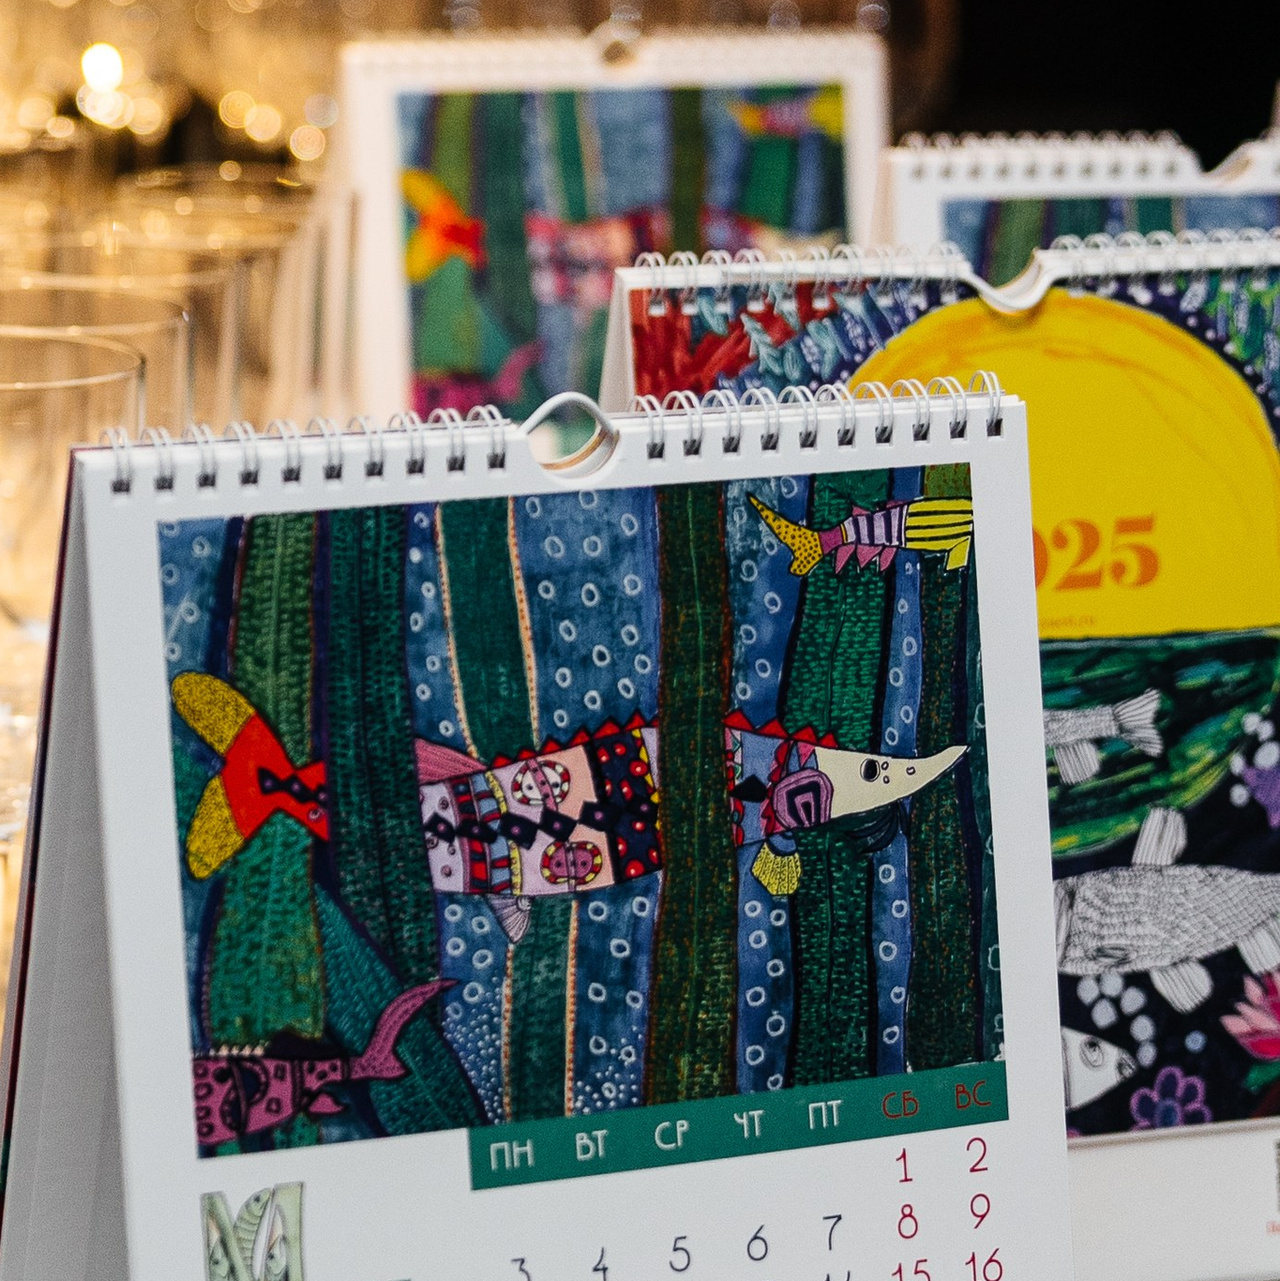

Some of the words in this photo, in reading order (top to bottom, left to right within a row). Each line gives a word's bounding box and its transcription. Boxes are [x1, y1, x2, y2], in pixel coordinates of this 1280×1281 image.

[489, 1138, 535, 1171] ПН
[575, 1129, 608, 1161] ВТ
[654, 1120, 689, 1151] СР
[733, 1109, 765, 1139] ЧТ
[808, 1099, 843, 1130] ПТ
[882, 1090, 920, 1119] СБ
[955, 1080, 991, 1110] ВС
[896, 1148, 913, 1183] 1
[966, 1137, 988, 1173] 2
[592, 1248, 608, 1281] 4
[669, 1236, 691, 1272] 5
[747, 1225, 768, 1261] 6
[823, 1214, 842, 1250] 7
[898, 1204, 918, 1239] 8
[970, 1193, 990, 1229] 9
